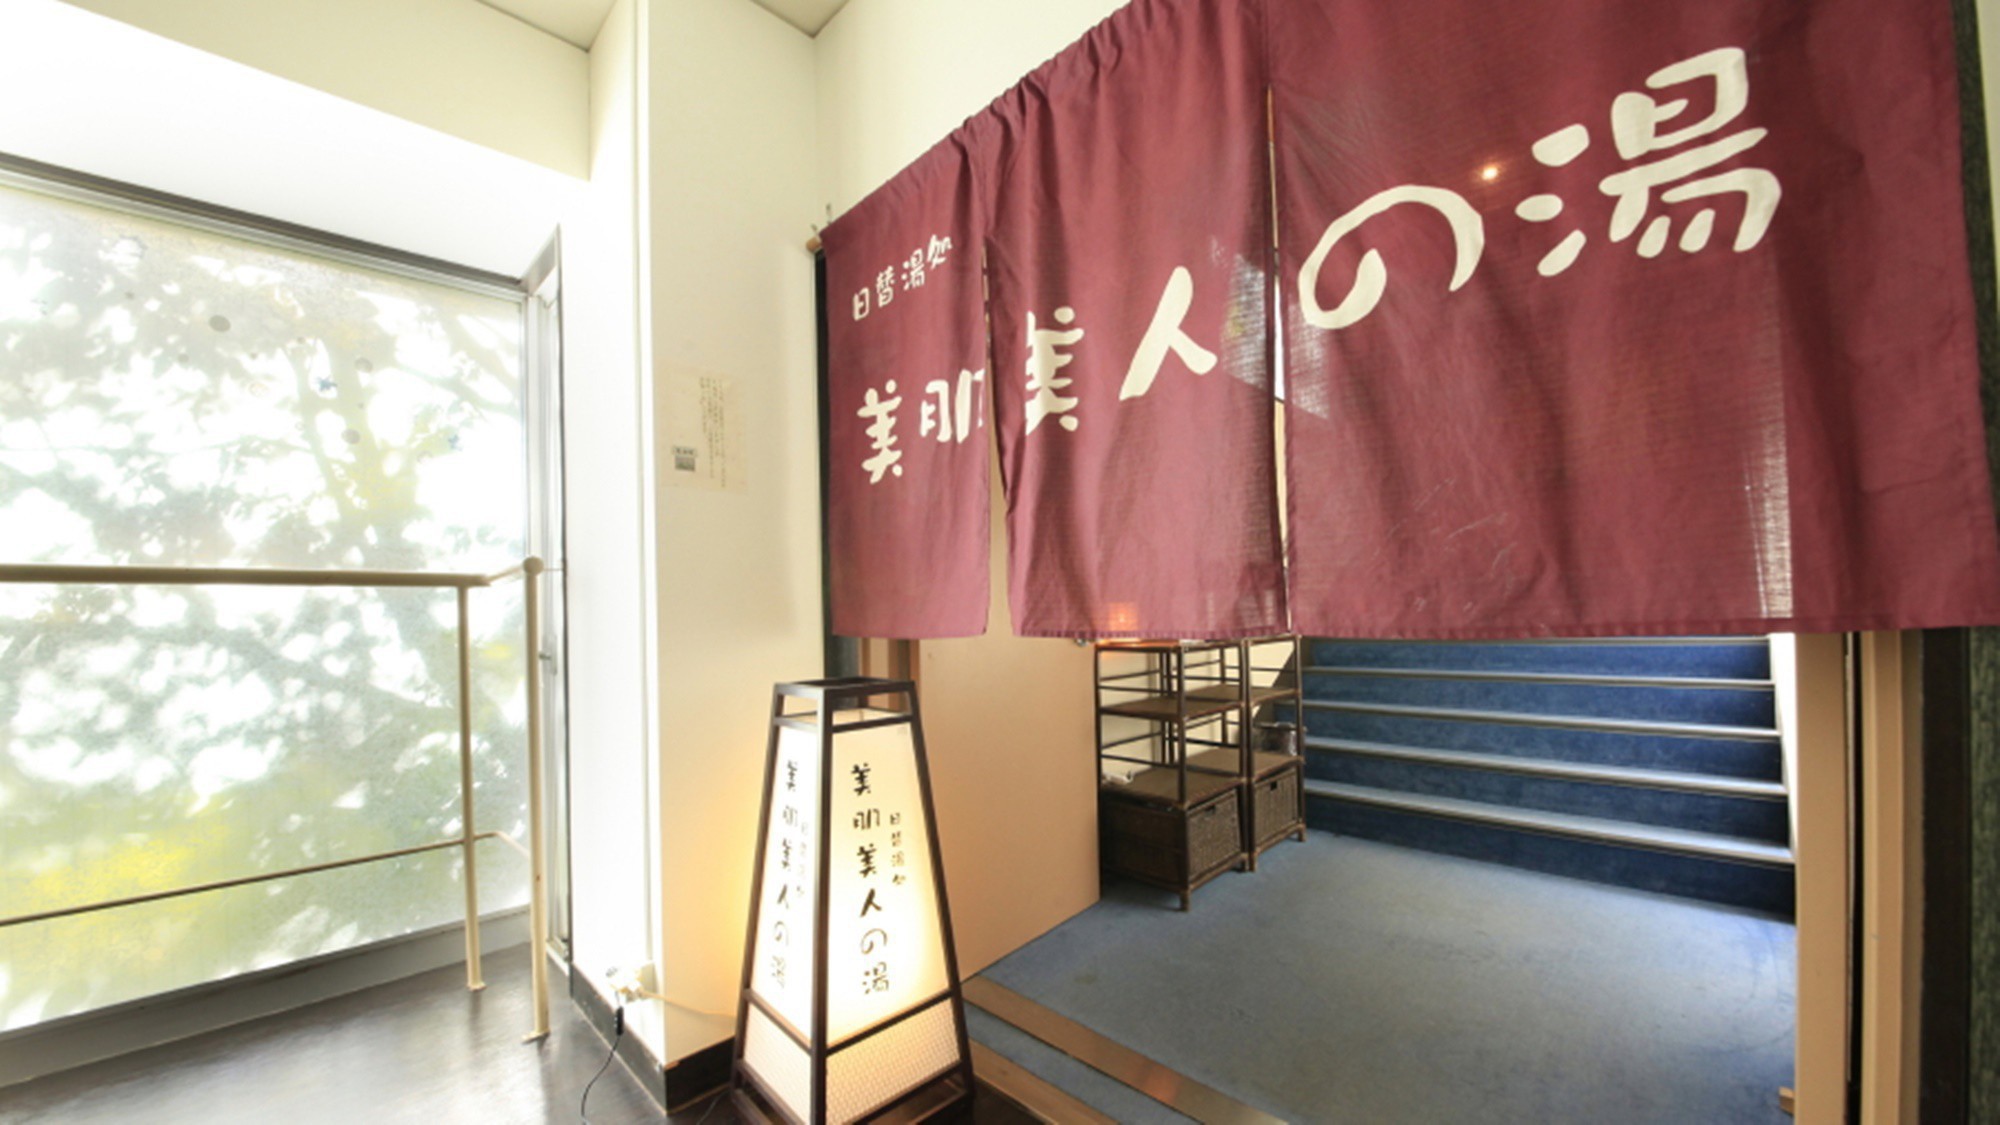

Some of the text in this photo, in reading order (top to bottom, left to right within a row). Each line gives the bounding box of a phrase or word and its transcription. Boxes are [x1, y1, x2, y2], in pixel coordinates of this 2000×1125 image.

[851, 762, 890, 995] 美肌美人の湯
